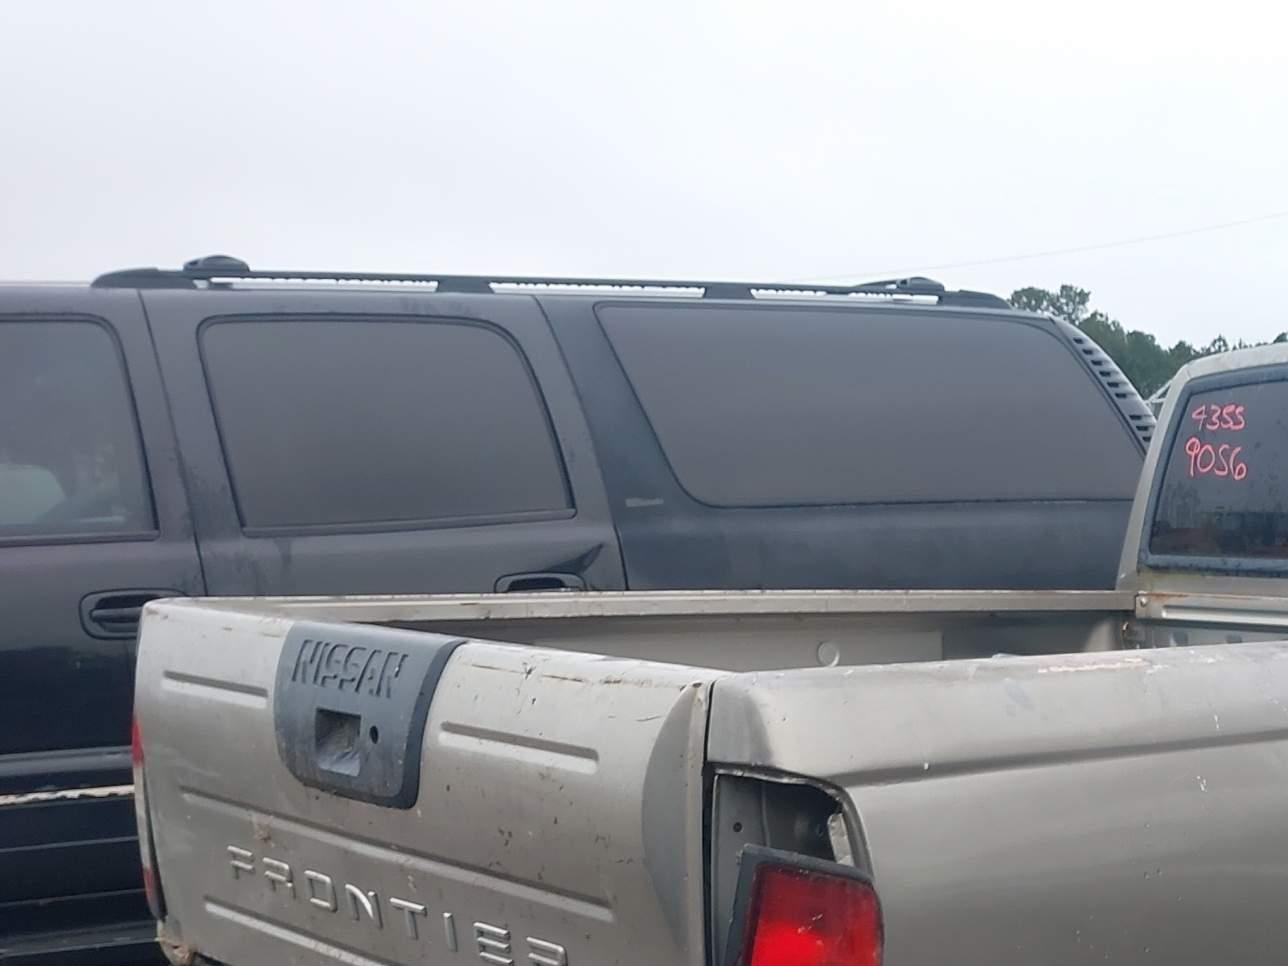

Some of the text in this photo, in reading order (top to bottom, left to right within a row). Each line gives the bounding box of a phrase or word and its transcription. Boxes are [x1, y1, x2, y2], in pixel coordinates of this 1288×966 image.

[1191, 404, 1246, 431] 4355
[1185, 437, 1248, 480] 9056
[291, 639, 409, 699] NISSAN
